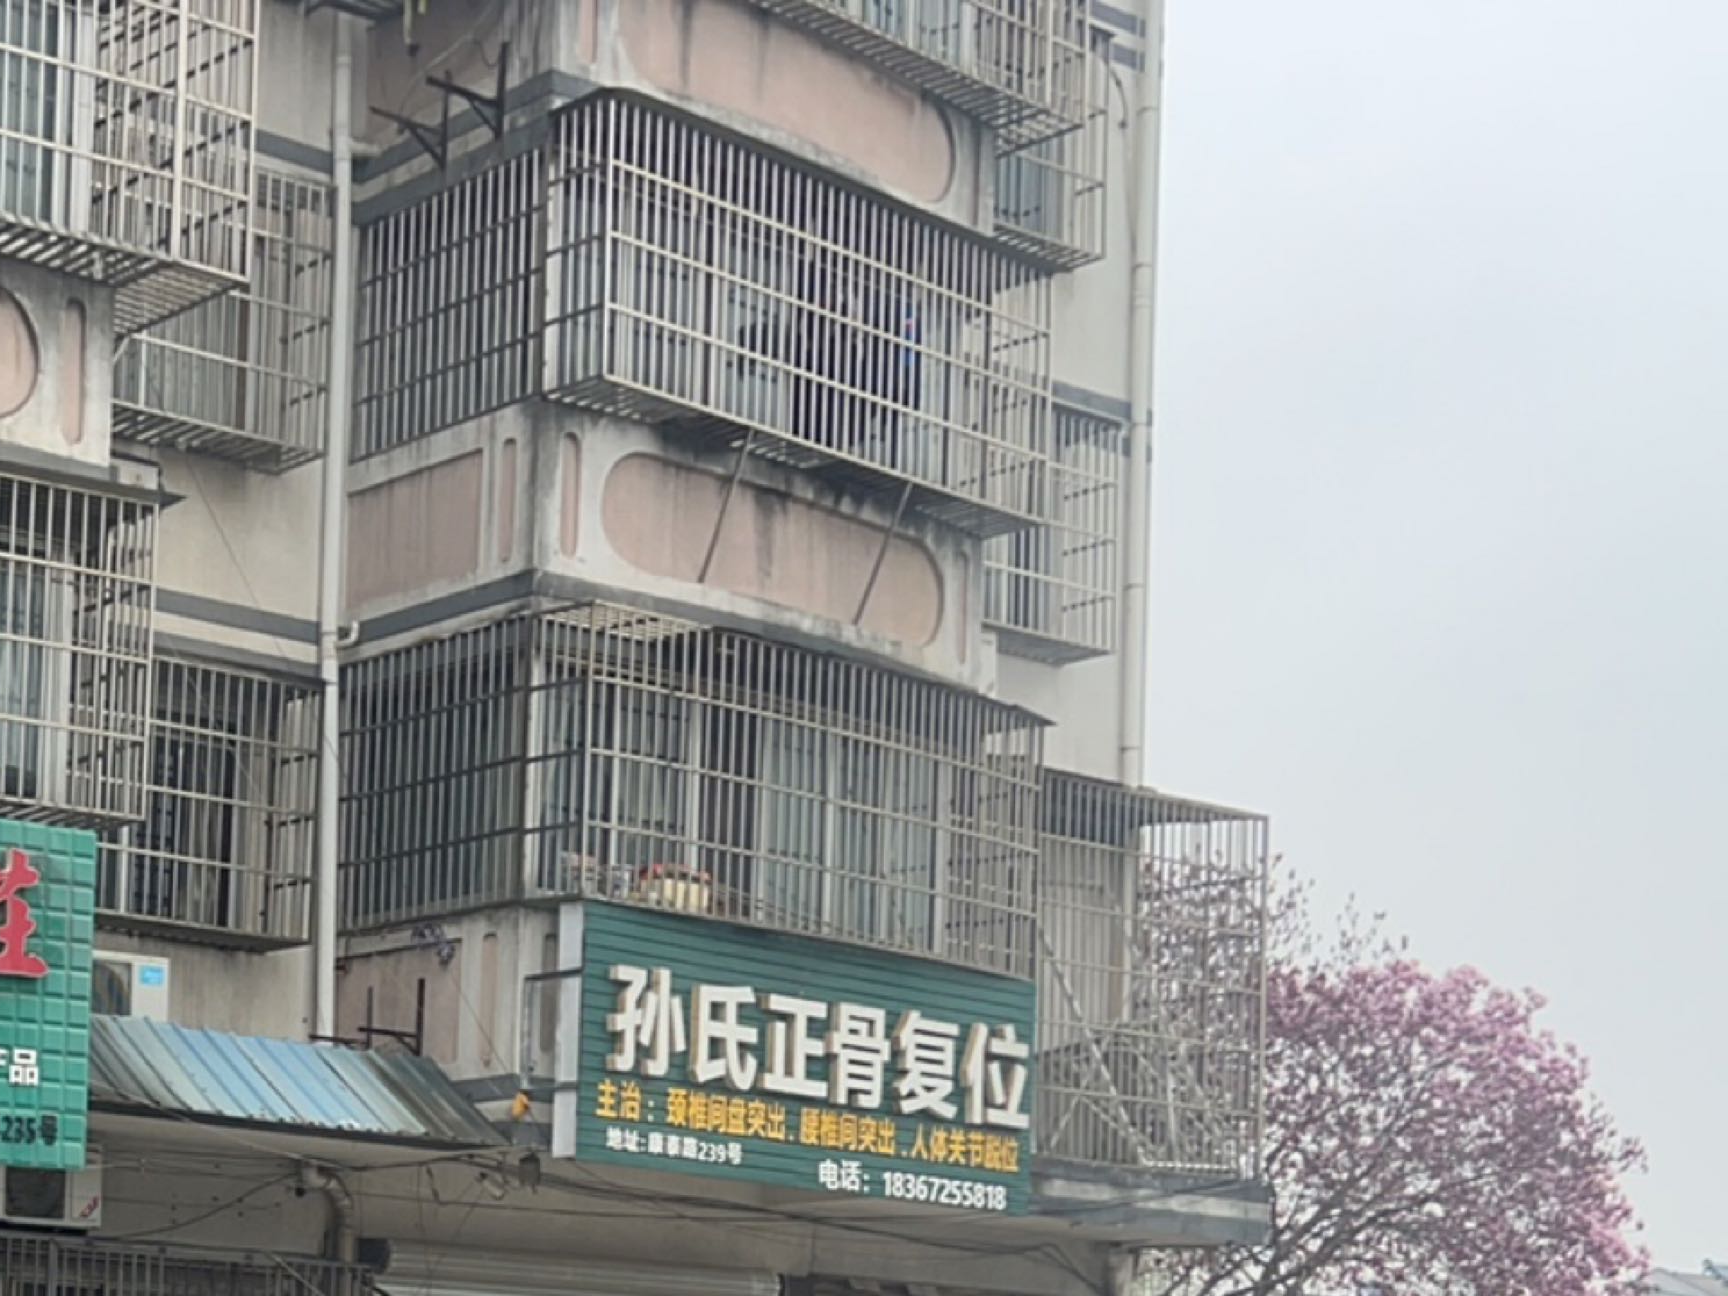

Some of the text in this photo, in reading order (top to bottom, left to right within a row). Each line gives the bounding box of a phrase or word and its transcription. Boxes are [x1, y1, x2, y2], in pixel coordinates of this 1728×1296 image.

[605, 963, 1031, 1129] 孙氏正骨复位
